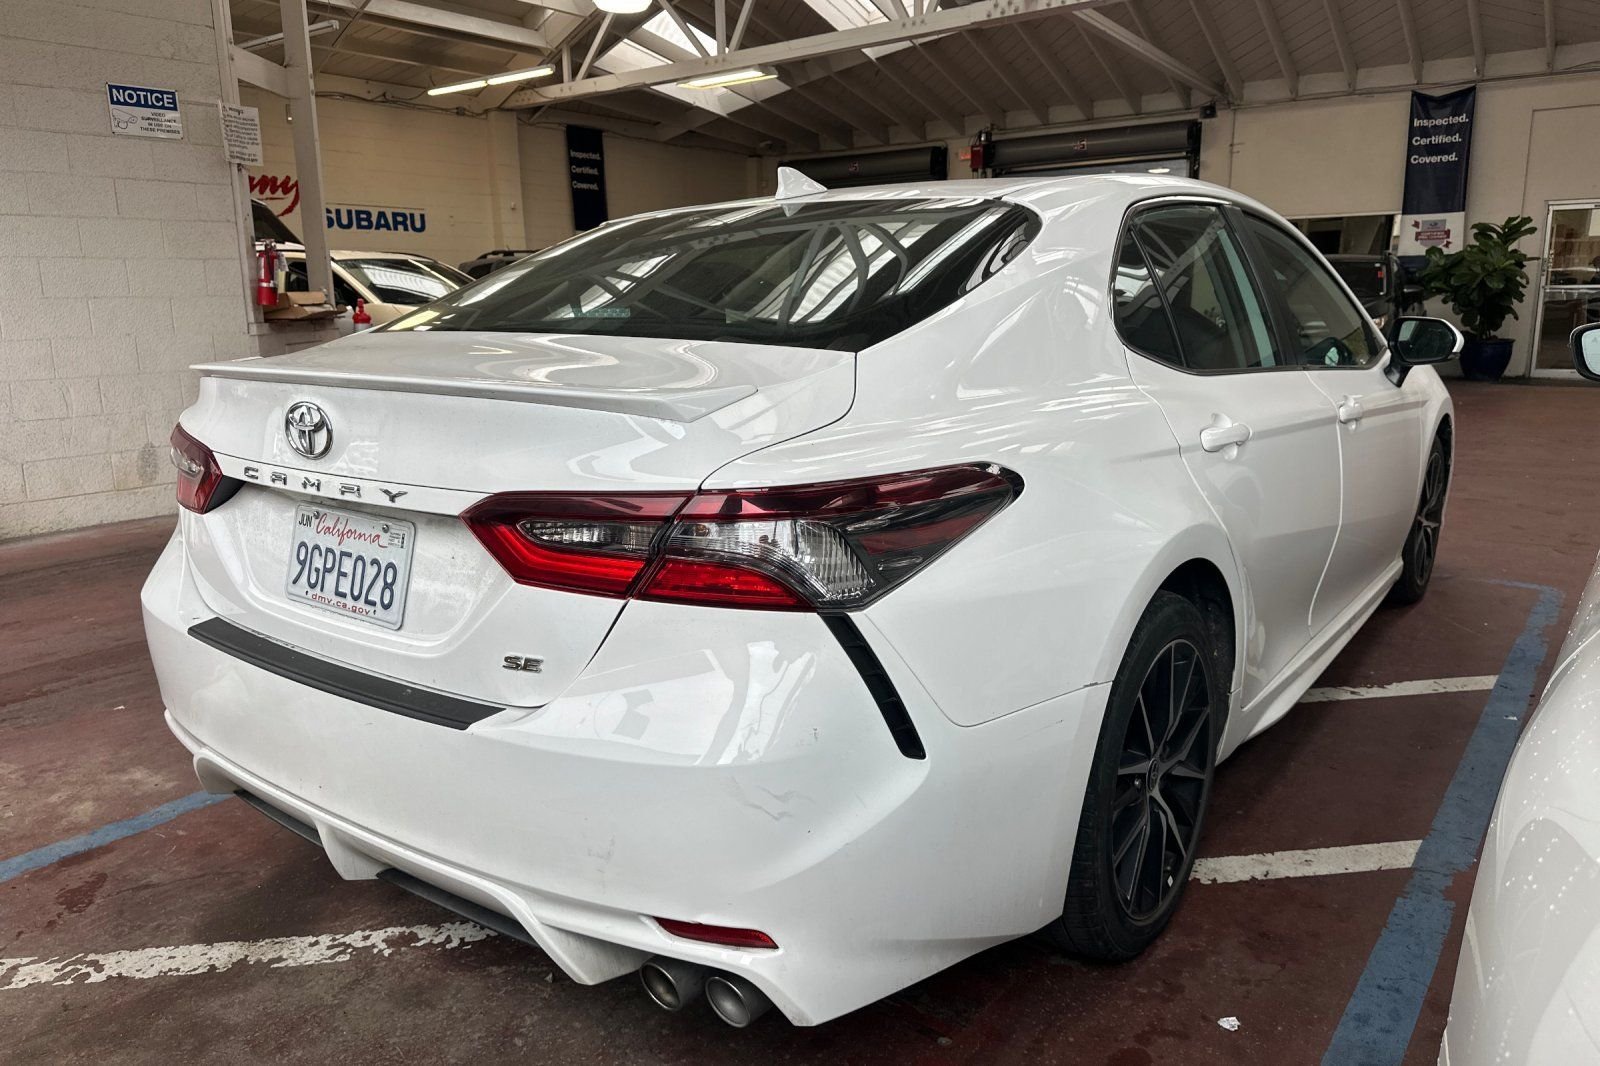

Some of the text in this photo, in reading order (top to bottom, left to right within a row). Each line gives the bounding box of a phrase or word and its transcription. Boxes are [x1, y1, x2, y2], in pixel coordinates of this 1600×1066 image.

[112, 88, 174, 107] NOTICE
[1414, 113, 1469, 128] Inspected.
[1412, 133, 1462, 146] Certified.
[570, 149, 600, 160] Inspected.
[1410, 152, 1458, 164] Covered.
[571, 165, 599, 175] Certified.
[572, 181, 599, 191] Covered.
[244, 466, 408, 503] CAMRY
[299, 513, 313, 527] JUN
[316, 512, 388, 548] California
[292, 541, 398, 611] 9GPE028
[311, 593, 371, 615] dmv.ca.gov
[502, 655, 544, 674] SE
